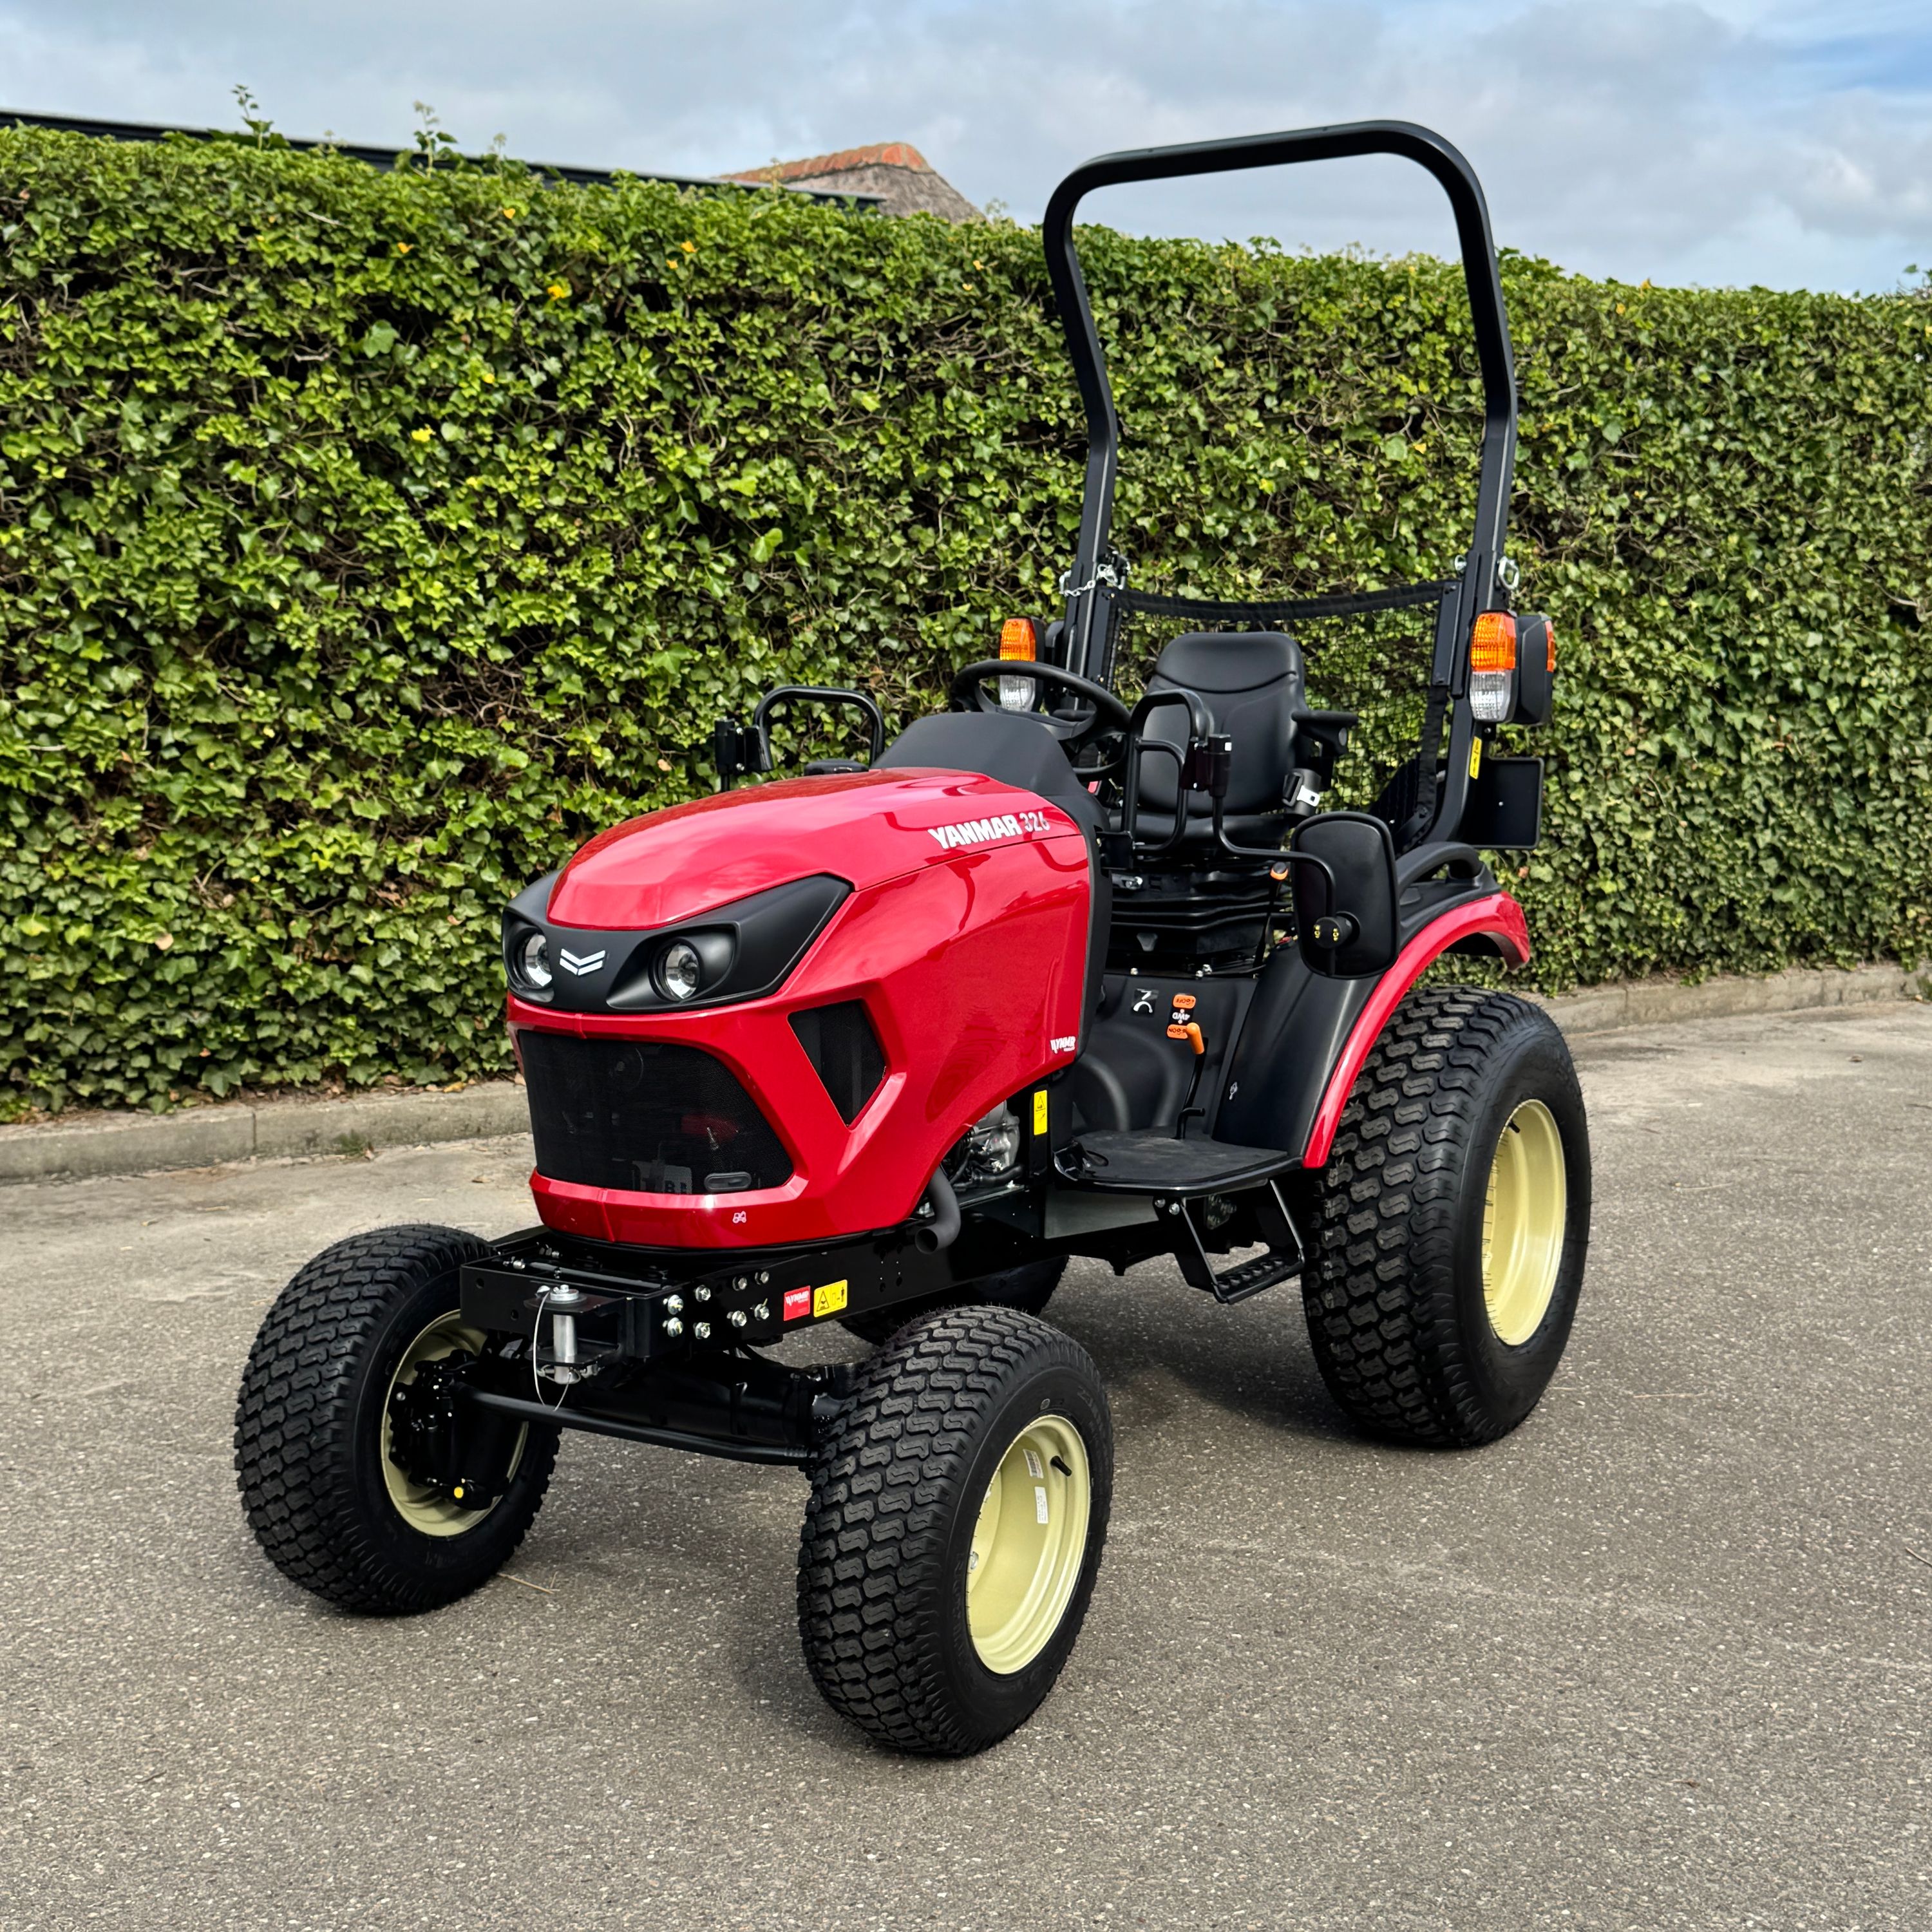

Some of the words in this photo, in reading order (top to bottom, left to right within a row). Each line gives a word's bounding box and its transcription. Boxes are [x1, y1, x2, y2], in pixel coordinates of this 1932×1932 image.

[927, 814, 1023, 849] YANMAR
[1019, 811, 1050, 832] 326
[1172, 1012, 1190, 1021] 4WD
